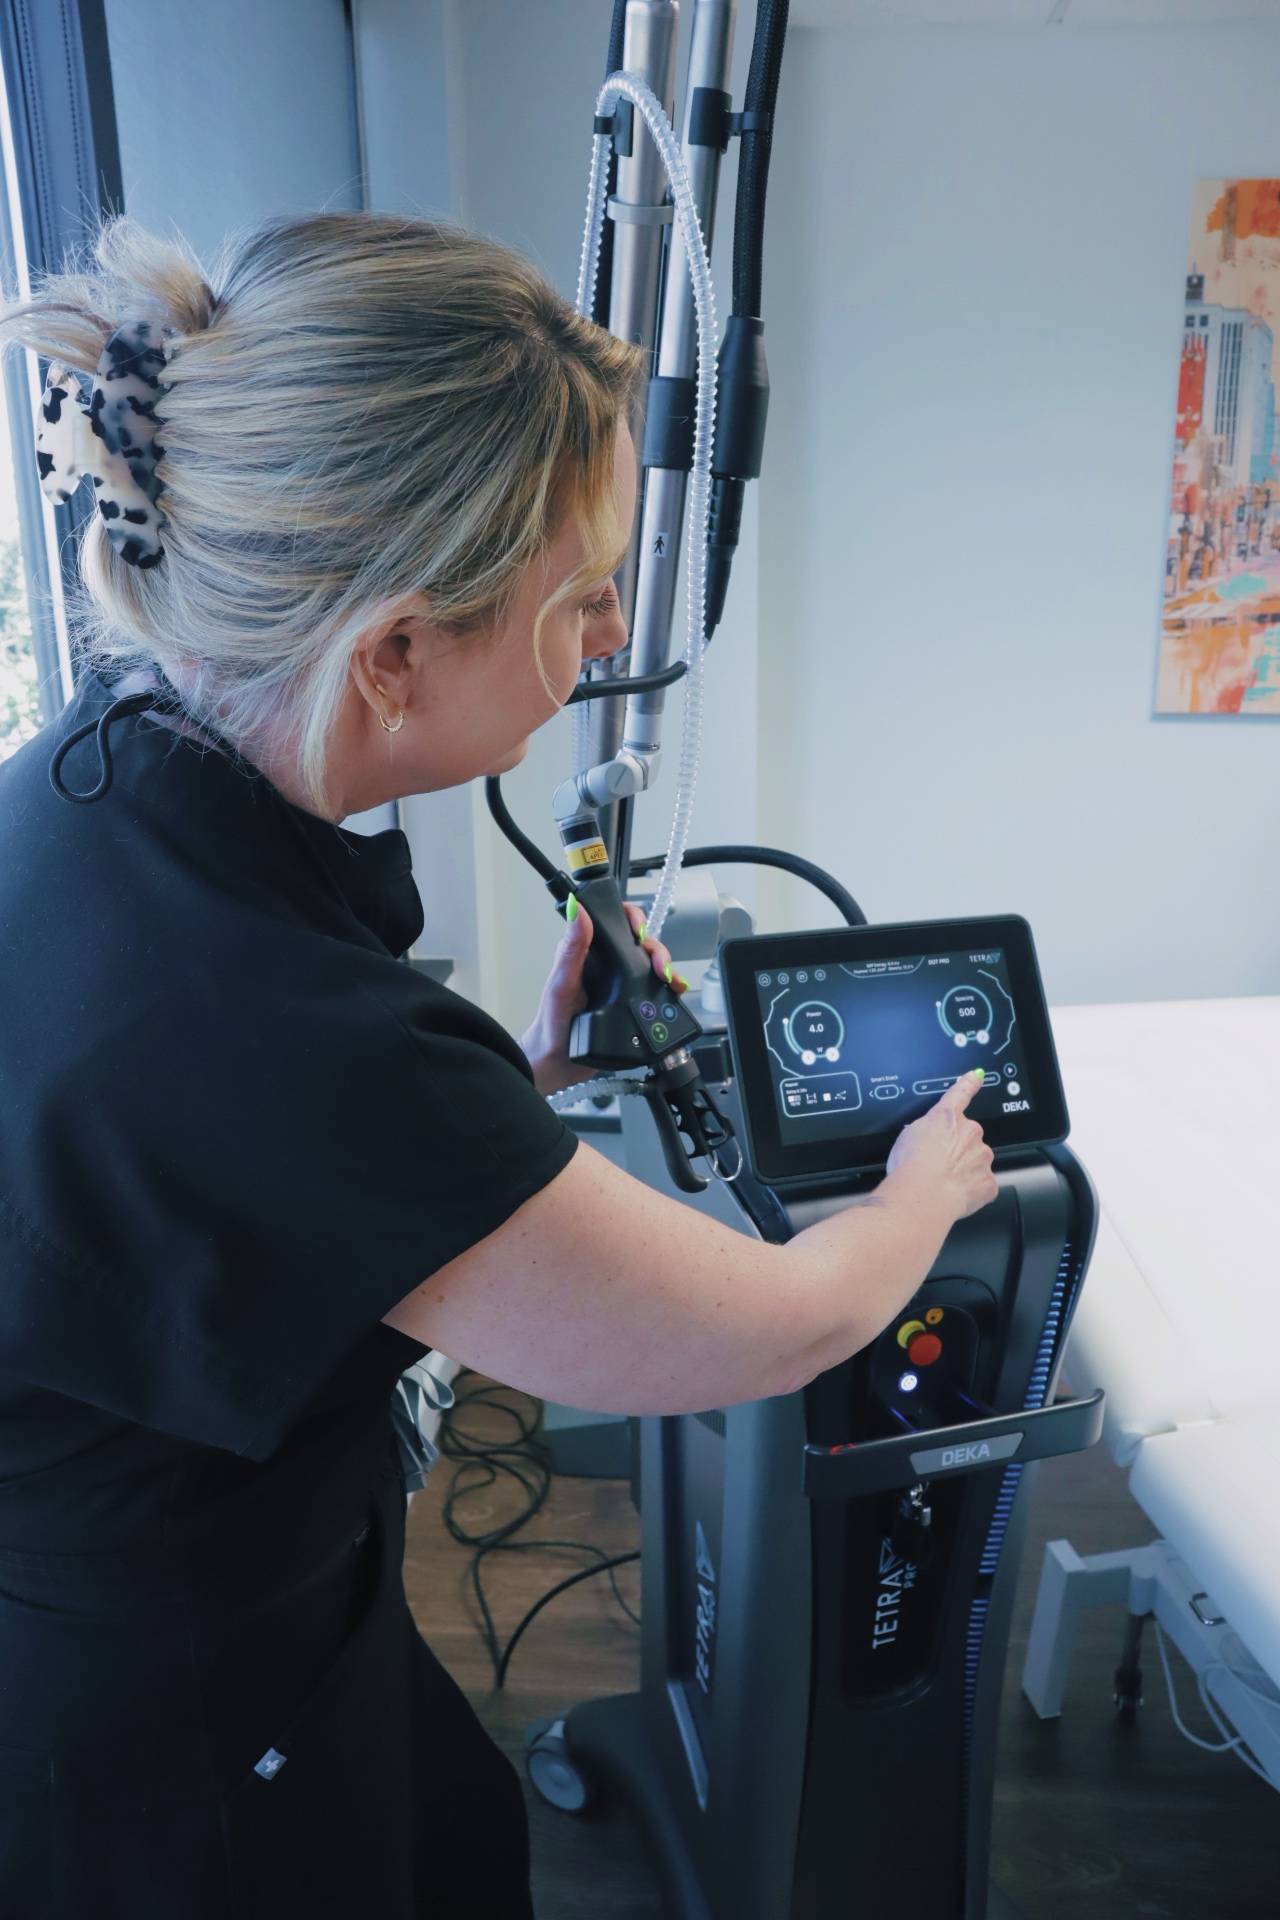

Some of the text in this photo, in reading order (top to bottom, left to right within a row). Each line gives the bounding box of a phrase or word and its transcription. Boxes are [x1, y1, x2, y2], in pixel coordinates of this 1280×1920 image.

[968, 954, 993, 964] TETRA
[959, 1007, 976, 1017] 500
[809, 1023, 824, 1033] 4.0
[1002, 1100, 1031, 1113] DEKA
[941, 1442, 991, 1468] DEKA
[872, 1568, 905, 1650] TETRA
